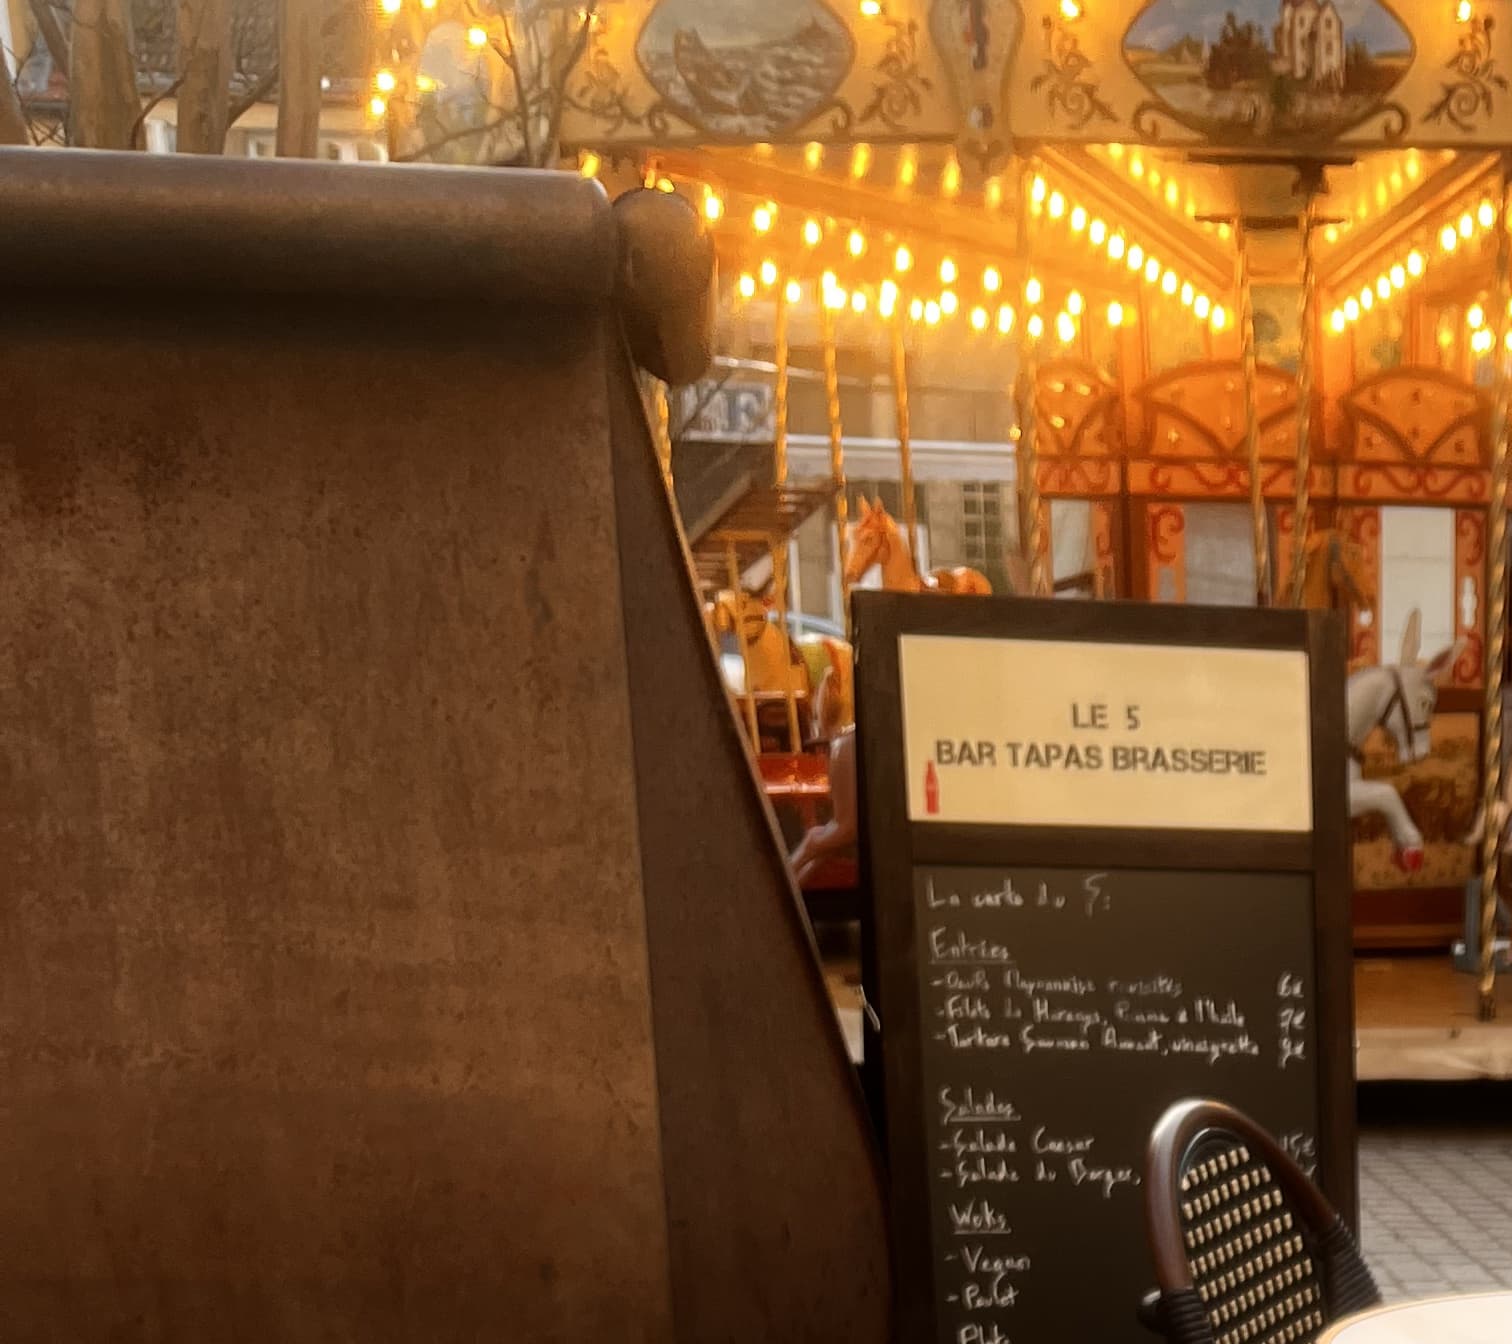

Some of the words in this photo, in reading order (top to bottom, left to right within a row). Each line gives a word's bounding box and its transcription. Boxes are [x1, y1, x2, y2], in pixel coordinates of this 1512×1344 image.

[1071, 703, 1108, 730] LE
[1126, 705, 1140, 730] 5
[936, 739, 996, 767] BAR
[1006, 742, 1103, 771] TAPAS
[1111, 745, 1266, 775] BRASSERIE
